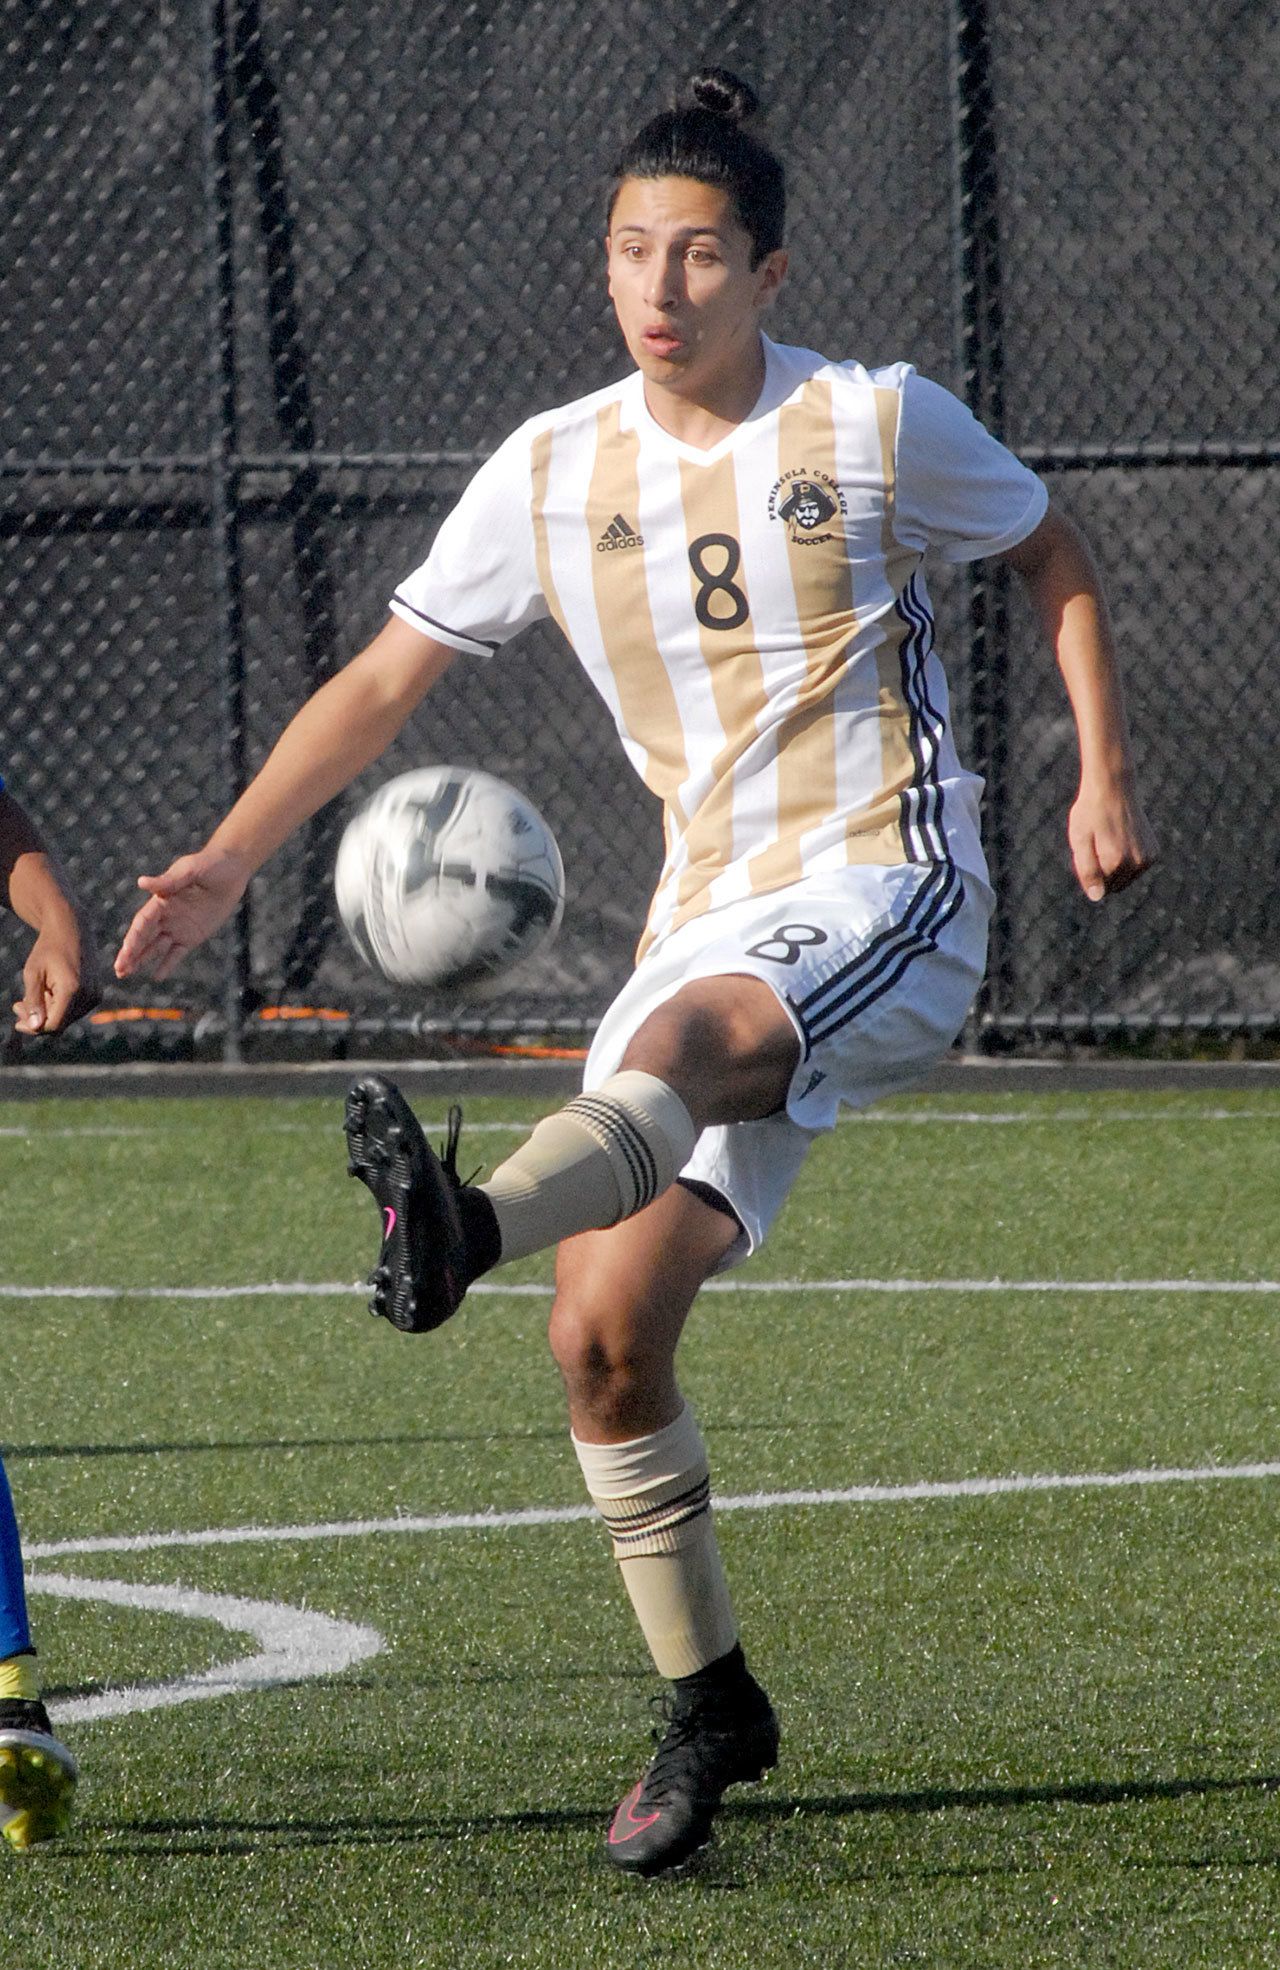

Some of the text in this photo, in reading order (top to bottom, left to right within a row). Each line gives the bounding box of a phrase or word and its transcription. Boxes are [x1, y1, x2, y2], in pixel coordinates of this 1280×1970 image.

[768, 468, 848, 520] PENINSULA COLLEGE
[597, 535, 645, 552] adidas
[791, 533, 832, 546] SOCCER
[688, 532, 750, 631] 8
[744, 924, 828, 966] 8
